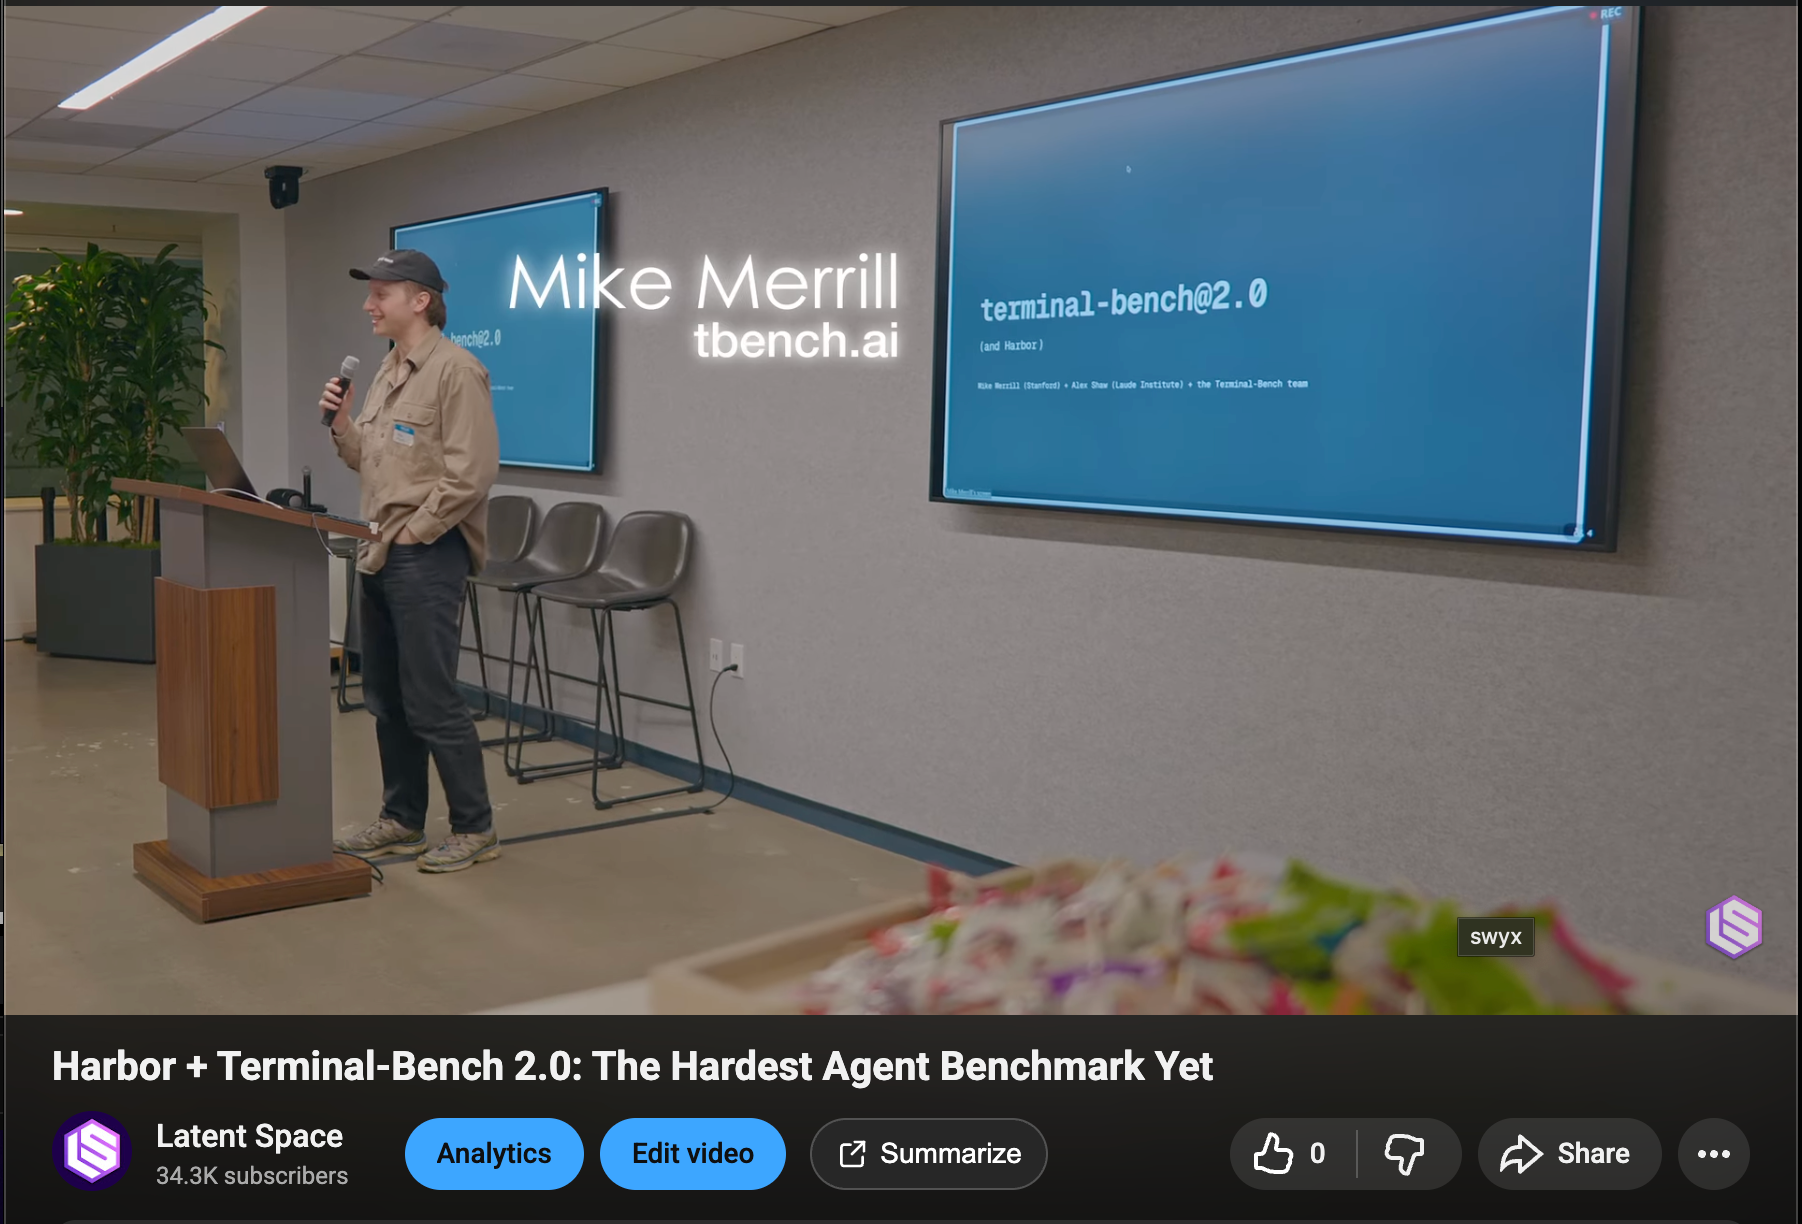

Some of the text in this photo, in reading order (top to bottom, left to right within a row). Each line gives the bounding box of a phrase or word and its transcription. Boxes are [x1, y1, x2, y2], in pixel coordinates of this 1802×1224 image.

[1601, 7, 1622, 19] REC
[981, 278, 1268, 322] terminal-bench@2.0
[980, 339, 1044, 352] (and Harbor)
[977, 382, 992, 390] Mike
[994, 382, 1020, 390] Merrill
[1023, 382, 1061, 390] (Stanford)
[1071, 381, 1088, 389] Alex
[1091, 381, 1108, 389] Shaw
[1111, 380, 1137, 390] (Laude
[1140, 380, 1184, 389] Institute)
[1197, 380, 1211, 389] the
[1215, 379, 1283, 389] Terminal-Bench
[1287, 379, 1309, 388] team
